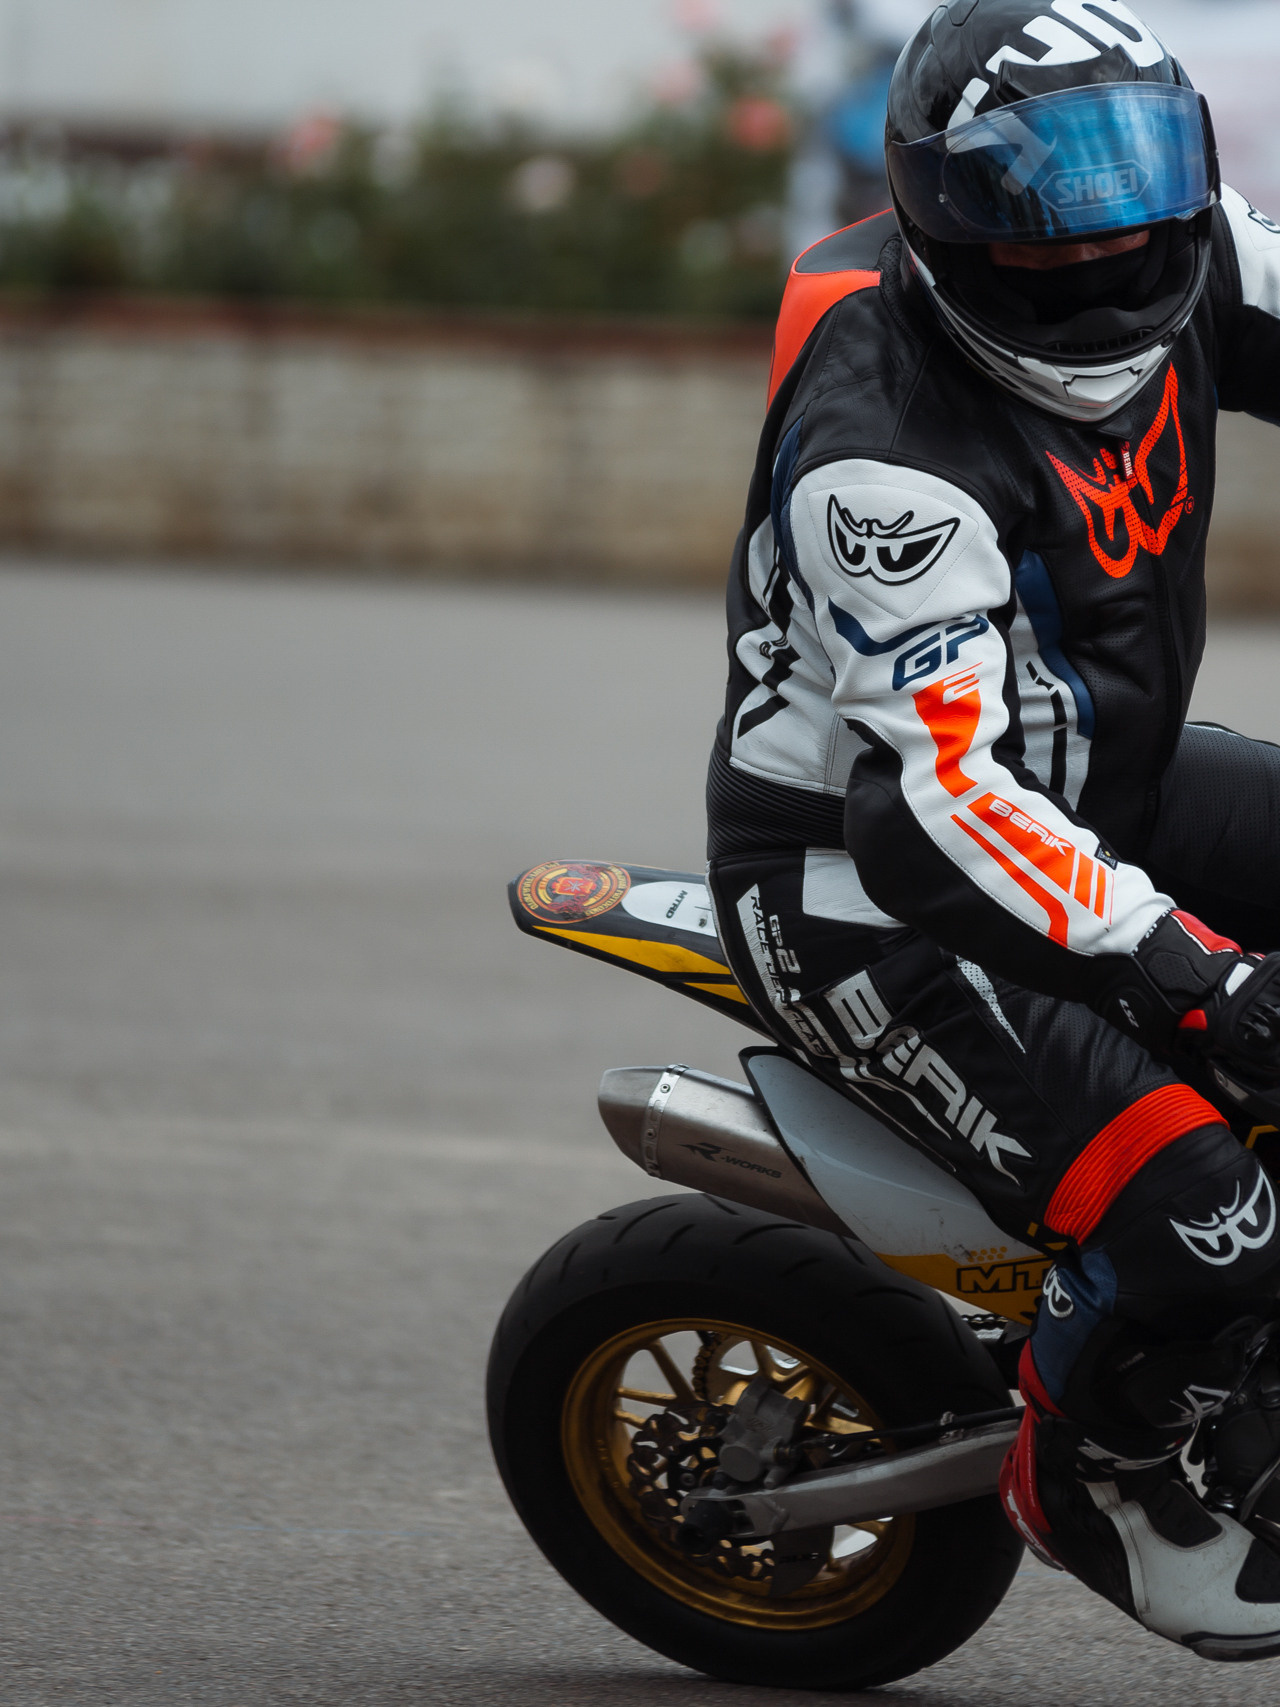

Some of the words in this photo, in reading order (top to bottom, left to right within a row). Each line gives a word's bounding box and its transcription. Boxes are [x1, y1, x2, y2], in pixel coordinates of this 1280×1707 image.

[1055, 167, 1138, 204] SHOEI
[1122, 451, 1133, 477] BERIK
[892, 613, 989, 691] GP
[988, 798, 1074, 857] BERIK
[665, 889, 688, 919] MTRD
[750, 894, 771, 955] RACE
[956, 1257, 1053, 1294] MT
